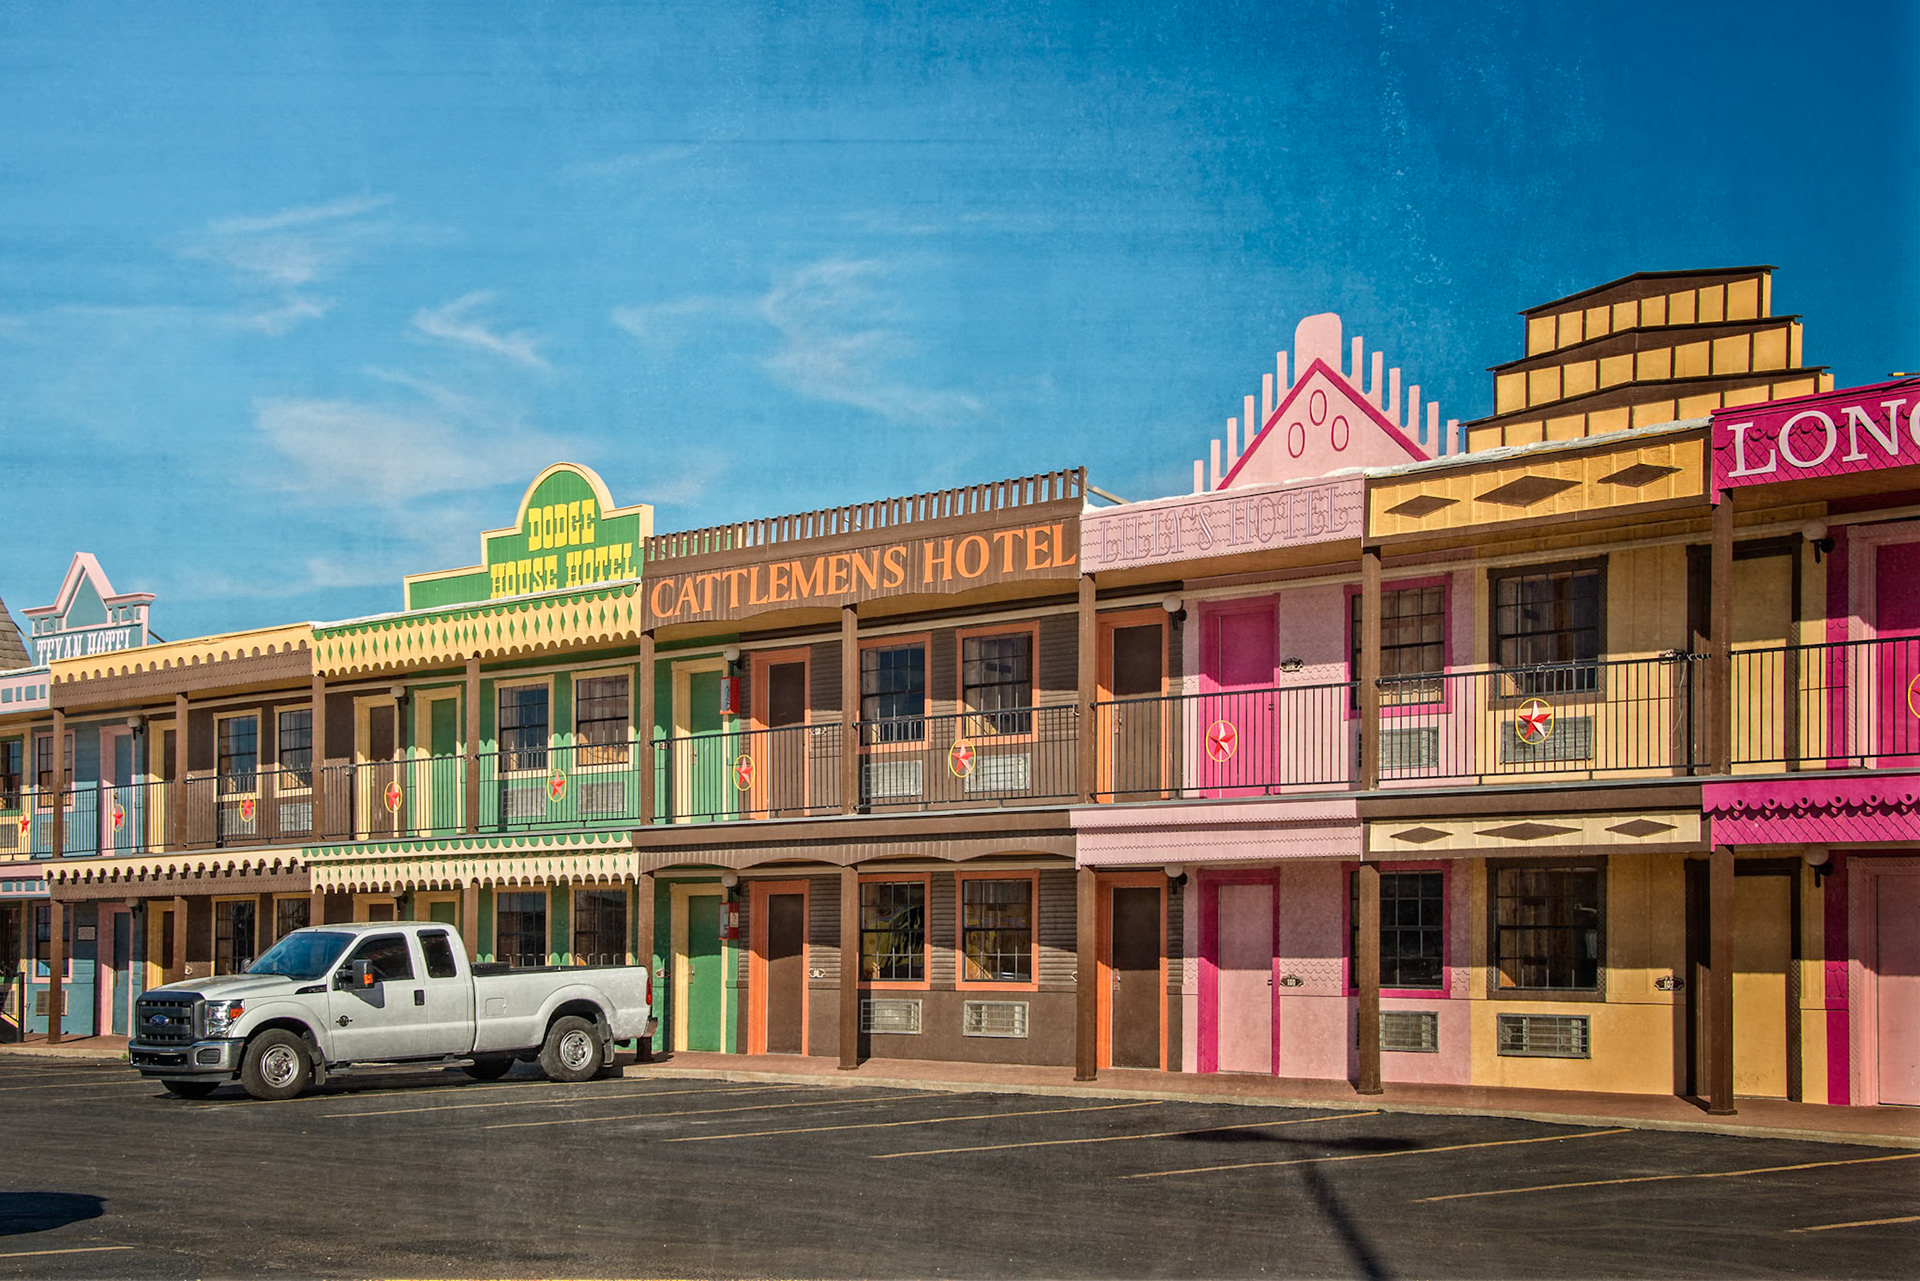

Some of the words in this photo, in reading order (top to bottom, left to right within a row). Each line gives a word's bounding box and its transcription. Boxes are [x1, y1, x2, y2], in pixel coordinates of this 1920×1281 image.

[1726, 398, 1920, 478] LON
[528, 498, 596, 552] DODGE
[1098, 505, 1215, 565] LILLY'S
[1226, 486, 1349, 548] HOTEL
[490, 554, 558, 600] HOUSE
[565, 542, 638, 587] HOTEL
[650, 545, 907, 619] CATTLEMENS
[922, 523, 1078, 584] HOTEL
